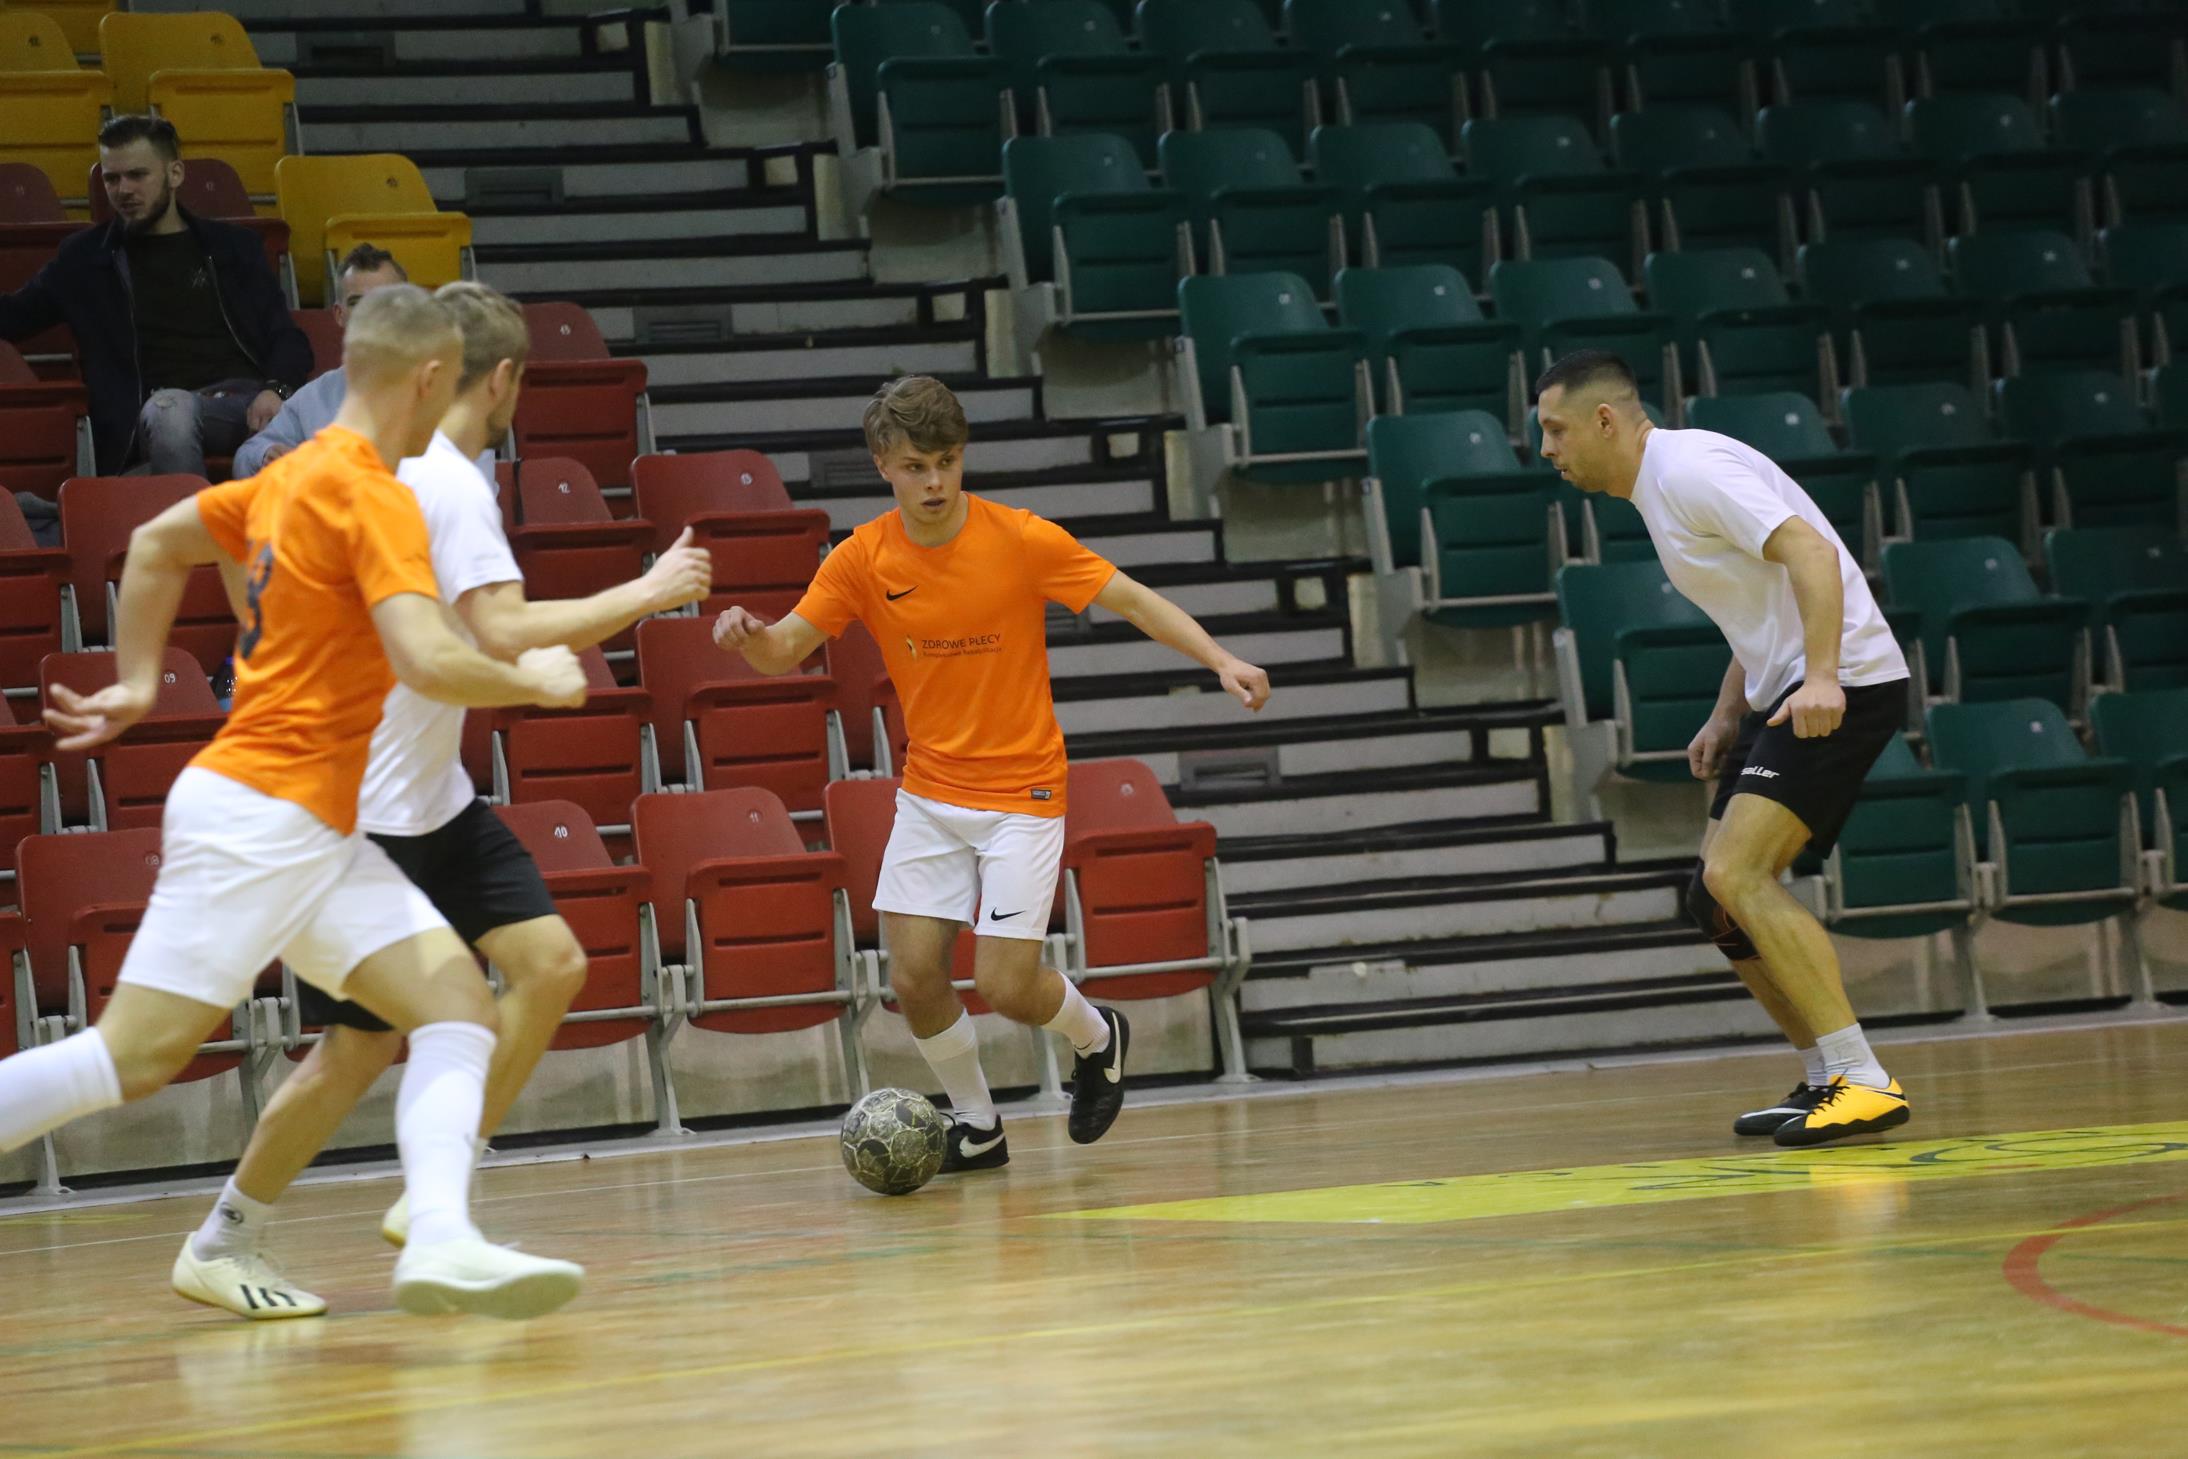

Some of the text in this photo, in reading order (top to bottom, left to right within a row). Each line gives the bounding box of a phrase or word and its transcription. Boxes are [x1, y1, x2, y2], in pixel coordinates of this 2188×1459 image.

[921, 639, 967, 650] ZDROWE
[164, 671, 177, 685] 09
[554, 825, 568, 839] 10
